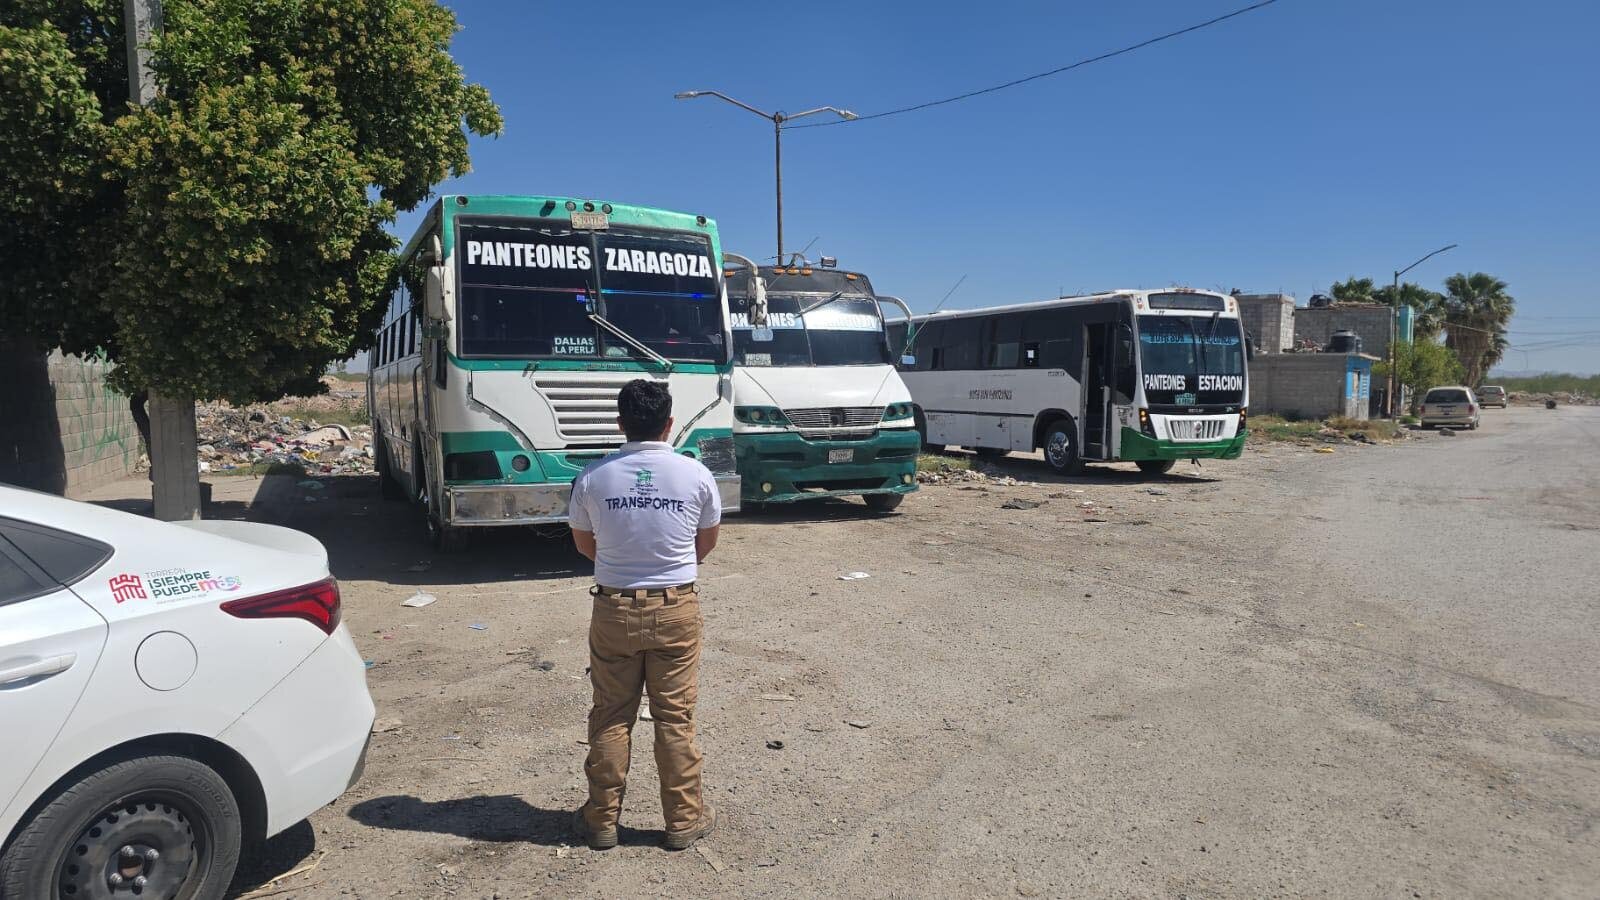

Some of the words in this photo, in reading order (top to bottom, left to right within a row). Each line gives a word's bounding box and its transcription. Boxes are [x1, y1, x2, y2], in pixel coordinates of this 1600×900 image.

[467, 240, 591, 270] PANTEONES
[605, 247, 713, 278] ZARAGOZA
[554, 337, 594, 346] DALIAS
[555, 346, 567, 354] LA
[1144, 374, 1186, 391] PANTEONES
[1198, 375, 1243, 391] ESTACION
[605, 496, 684, 512] TRANSPORTE
[147, 571, 210, 589] ¡SIEMPRE
[152, 583, 200, 598] PUEDE
